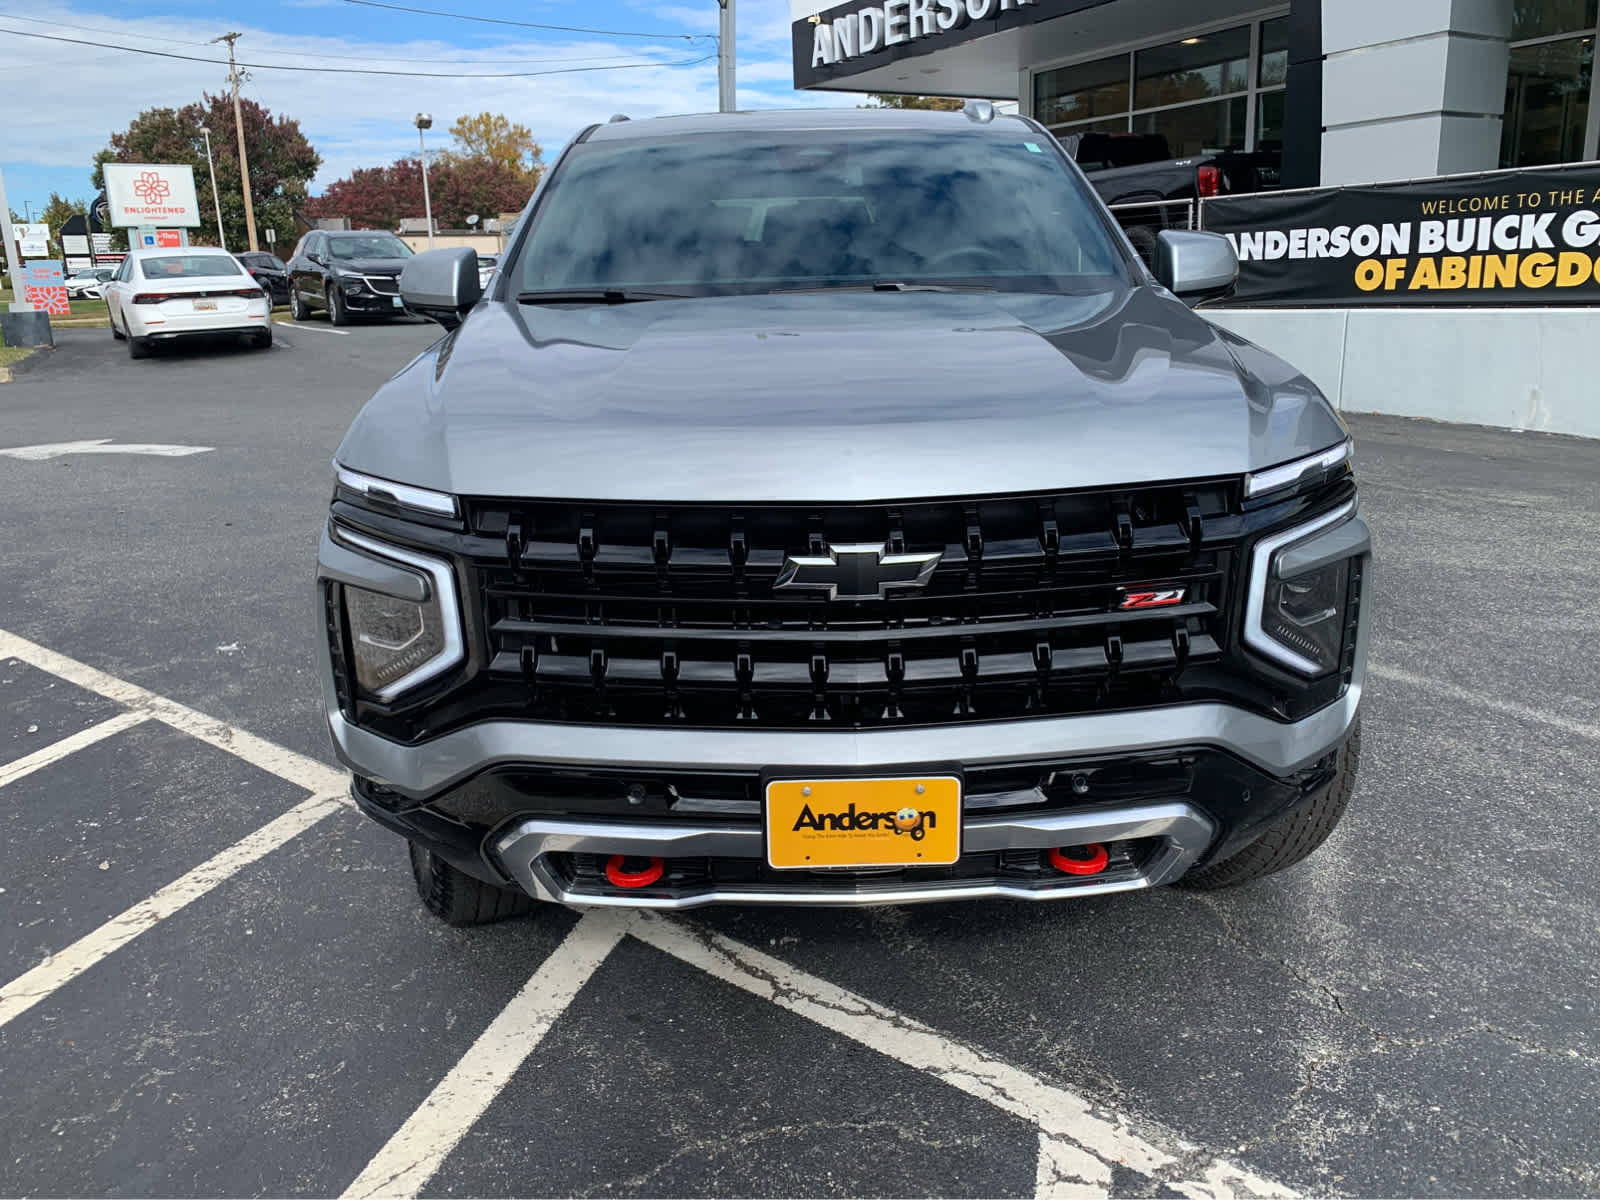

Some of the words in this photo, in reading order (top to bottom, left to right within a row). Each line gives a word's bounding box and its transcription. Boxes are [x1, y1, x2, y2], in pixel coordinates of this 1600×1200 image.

[811, 0, 1032, 68] ANDERSO
[1422, 195, 1510, 215] WELCOME
[1517, 192, 1541, 207] TO
[1549, 189, 1585, 206] THE
[1418, 212, 1557, 253] BUICK
[1354, 258, 1406, 292] OF
[1408, 251, 1600, 290] ABINGD
[1119, 589, 1185, 608] Z71
